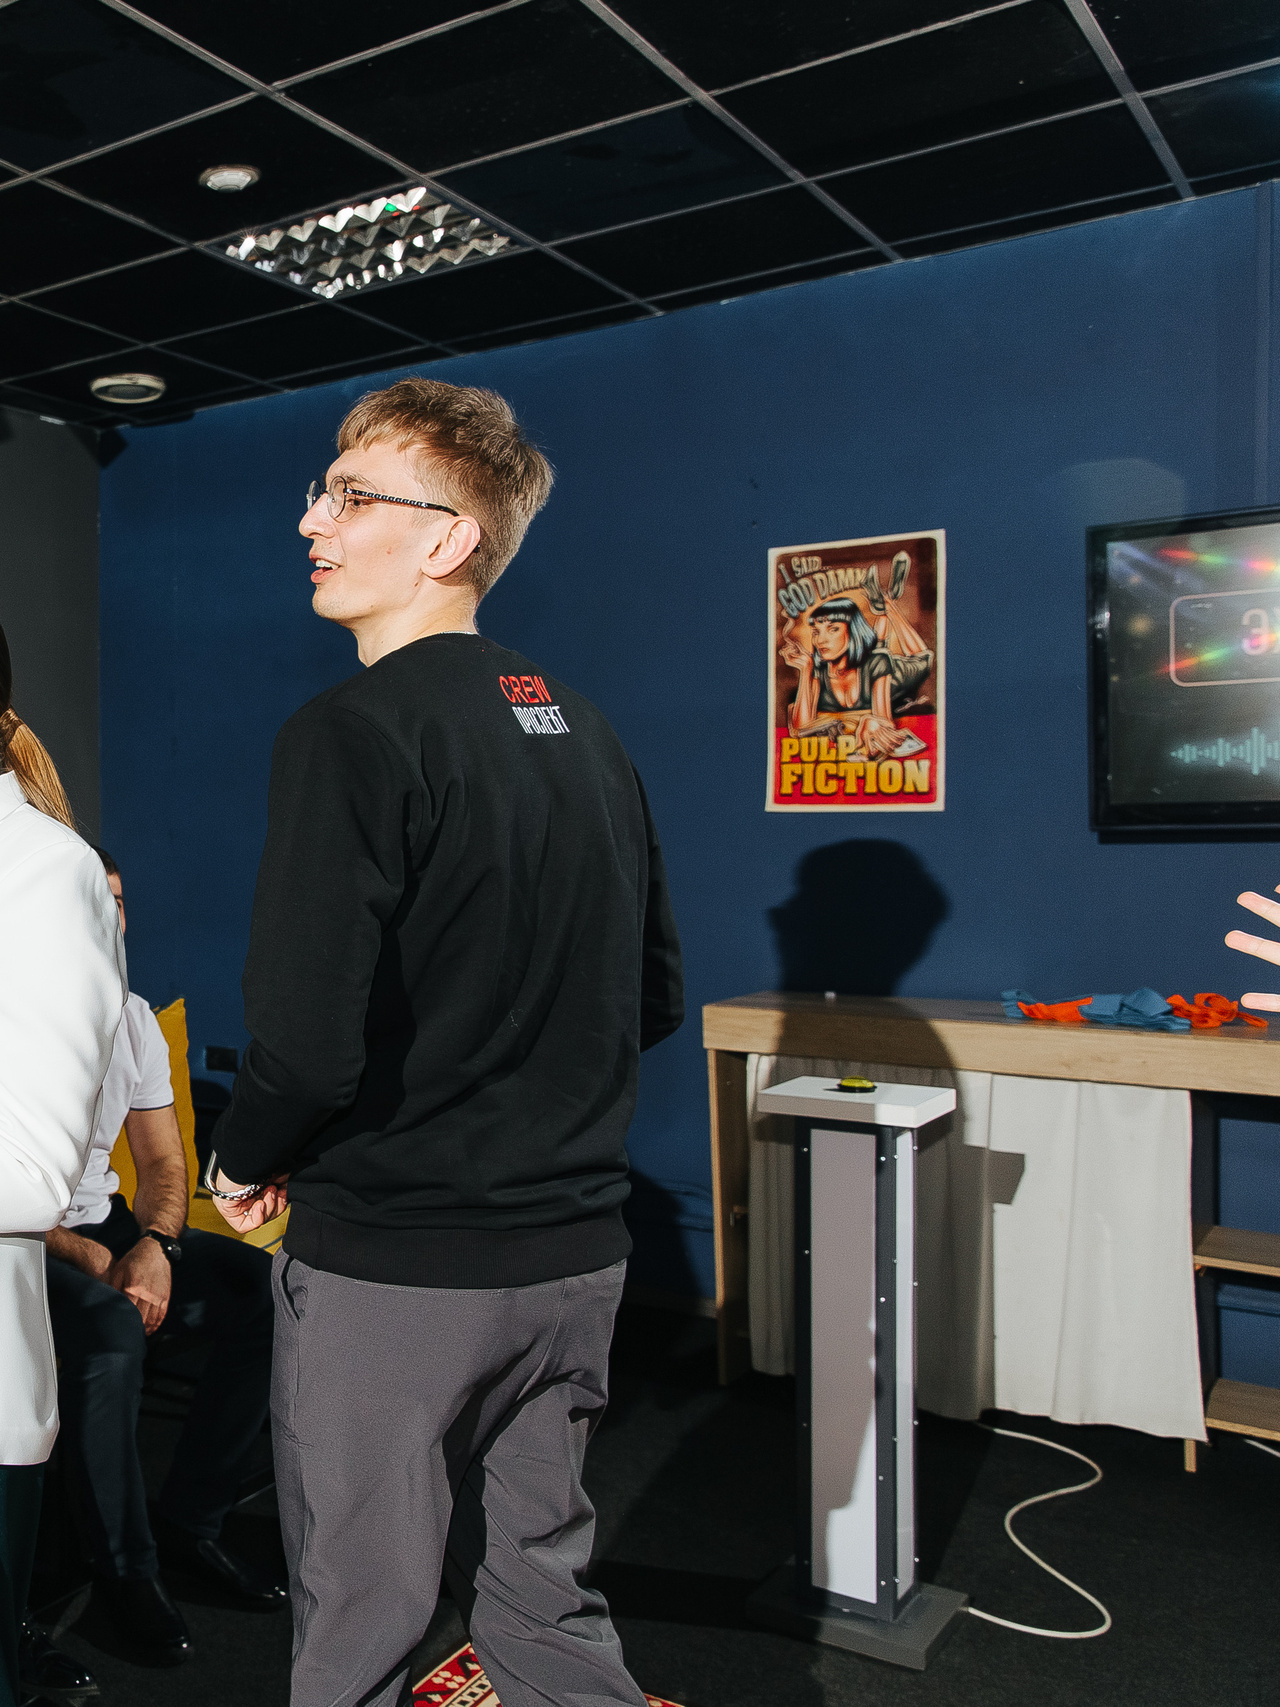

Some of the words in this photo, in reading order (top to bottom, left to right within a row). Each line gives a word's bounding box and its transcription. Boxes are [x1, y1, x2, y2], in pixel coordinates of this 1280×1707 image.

[778, 577, 816, 618] GOD
[499, 675, 552, 703] CREW
[781, 735, 857, 762] PULP
[780, 759, 931, 795] FICTION
